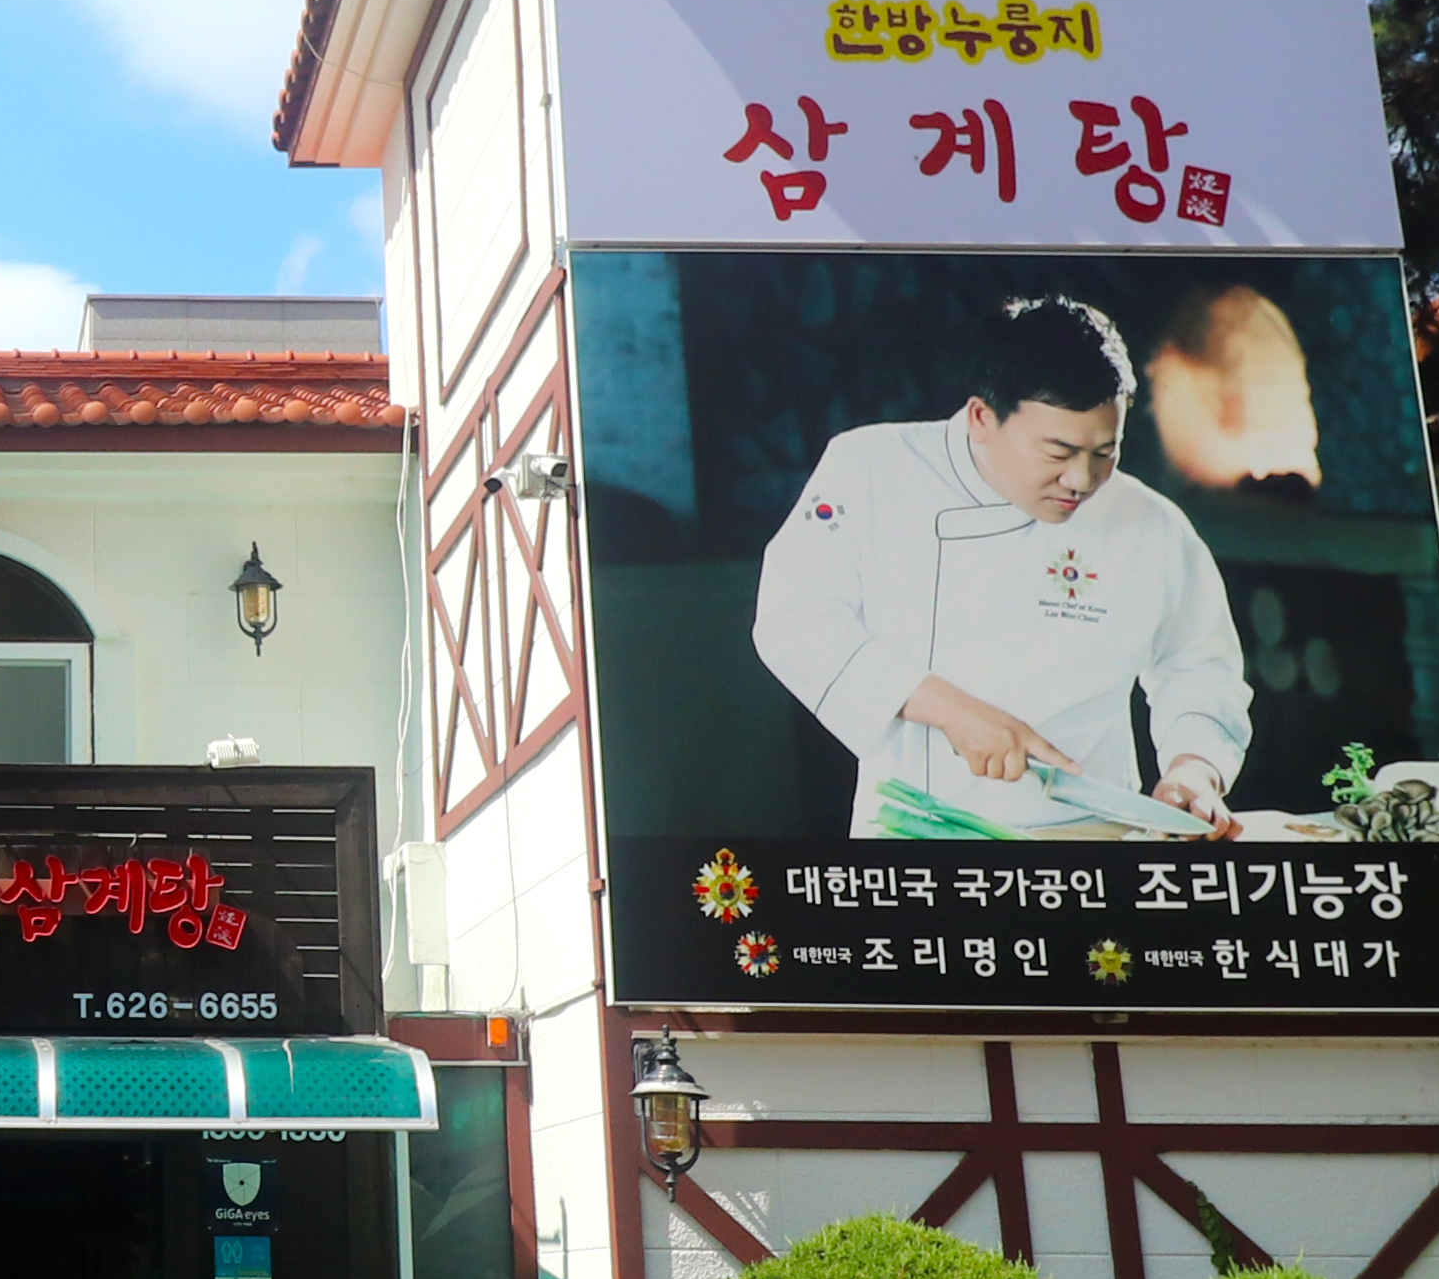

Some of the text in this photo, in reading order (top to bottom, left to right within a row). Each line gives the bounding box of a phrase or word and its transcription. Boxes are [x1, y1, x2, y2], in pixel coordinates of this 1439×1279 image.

[722, 95, 1189, 224] 삼계탕
[0, 853, 224, 949] 삼계탕
[786, 859, 1408, 919] 대한민국 국가공인 조리기능장
[793, 937, 1049, 976] 대한민국 조리명인
[1144, 938, 1399, 979] 대한민국 한식대가
[73, 991, 279, 1022] T.626-6655
